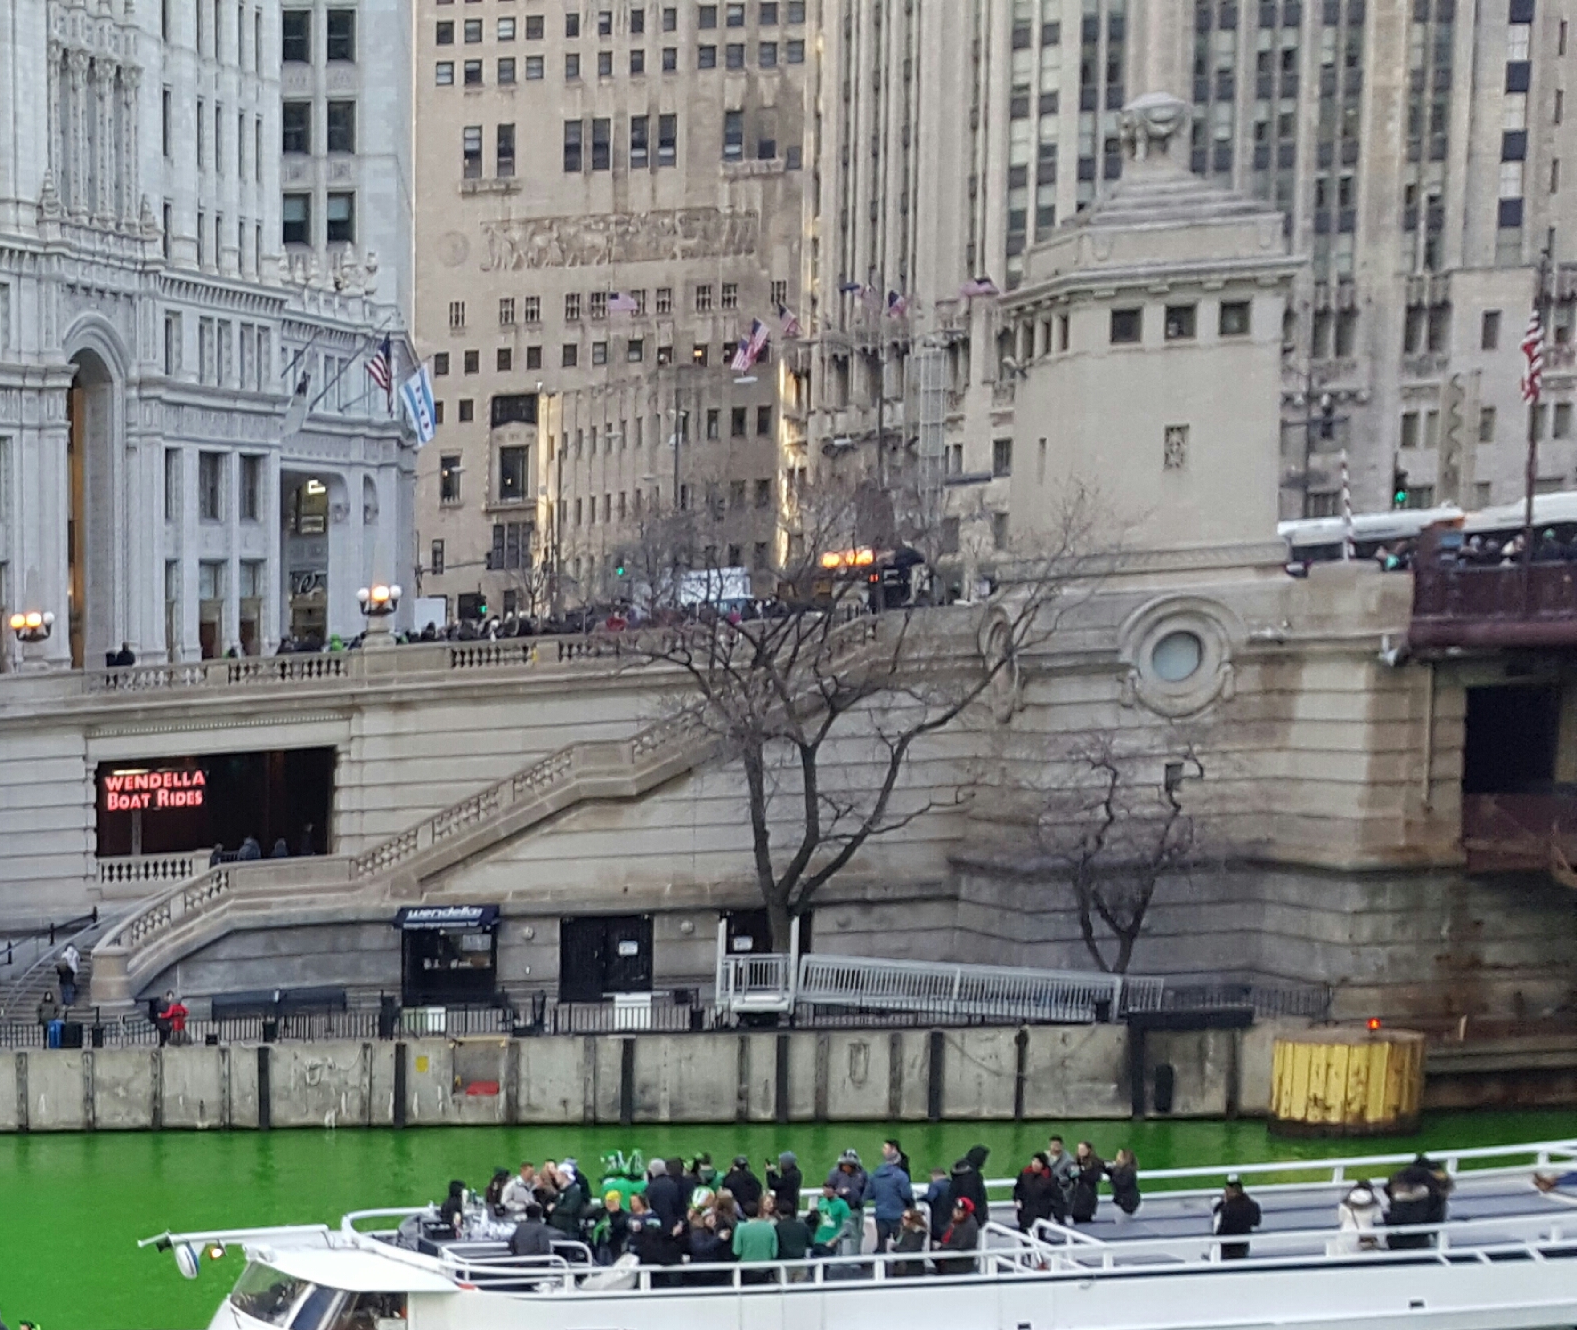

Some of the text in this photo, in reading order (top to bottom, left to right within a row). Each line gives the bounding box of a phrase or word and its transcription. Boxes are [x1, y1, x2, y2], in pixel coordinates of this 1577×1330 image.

[105, 770, 205, 790] WENDELLA
[107, 788, 203, 811] BOAT RIDES
